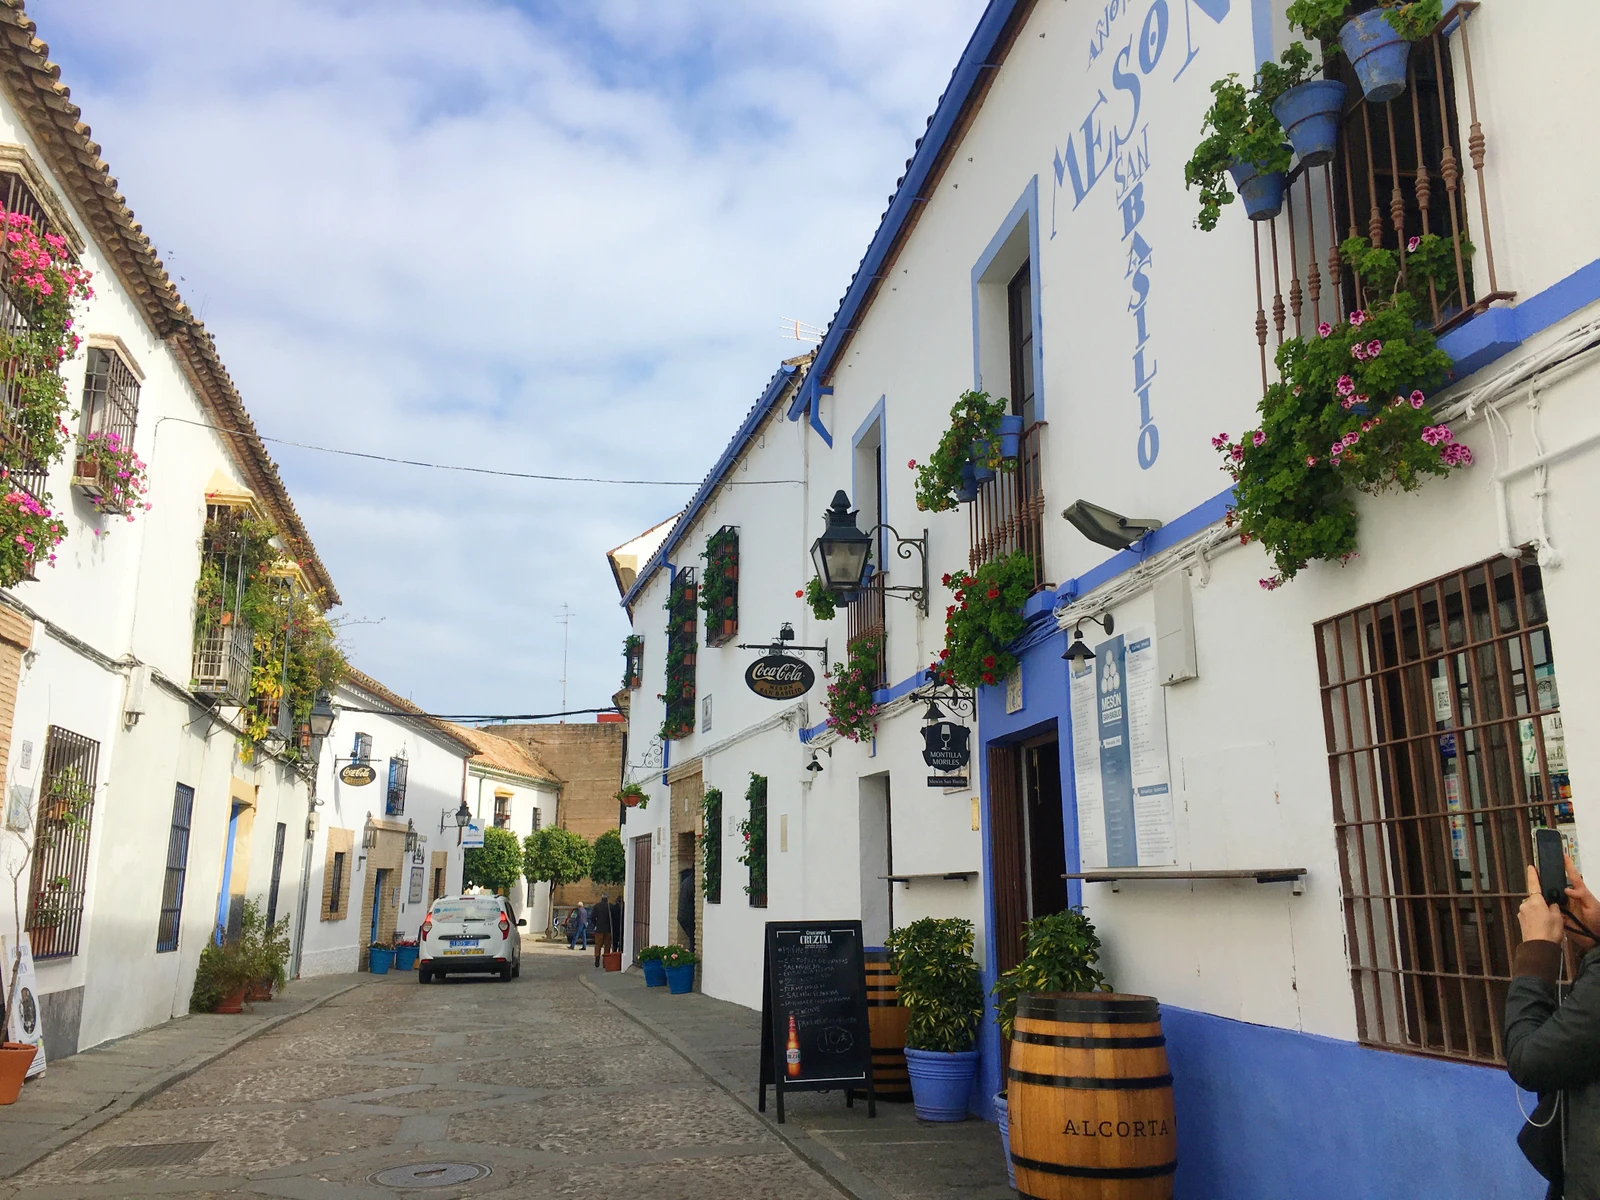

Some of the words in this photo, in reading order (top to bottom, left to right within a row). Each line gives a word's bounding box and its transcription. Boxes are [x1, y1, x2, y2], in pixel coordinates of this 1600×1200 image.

[1114, 123, 1151, 199] SAN
[1119, 181, 1160, 471] BASILIO
[775, 687, 802, 697] BASILIO
[800, 935, 832, 945] CRUZIAL
[1062, 1119, 1169, 1138] ALCORTA
